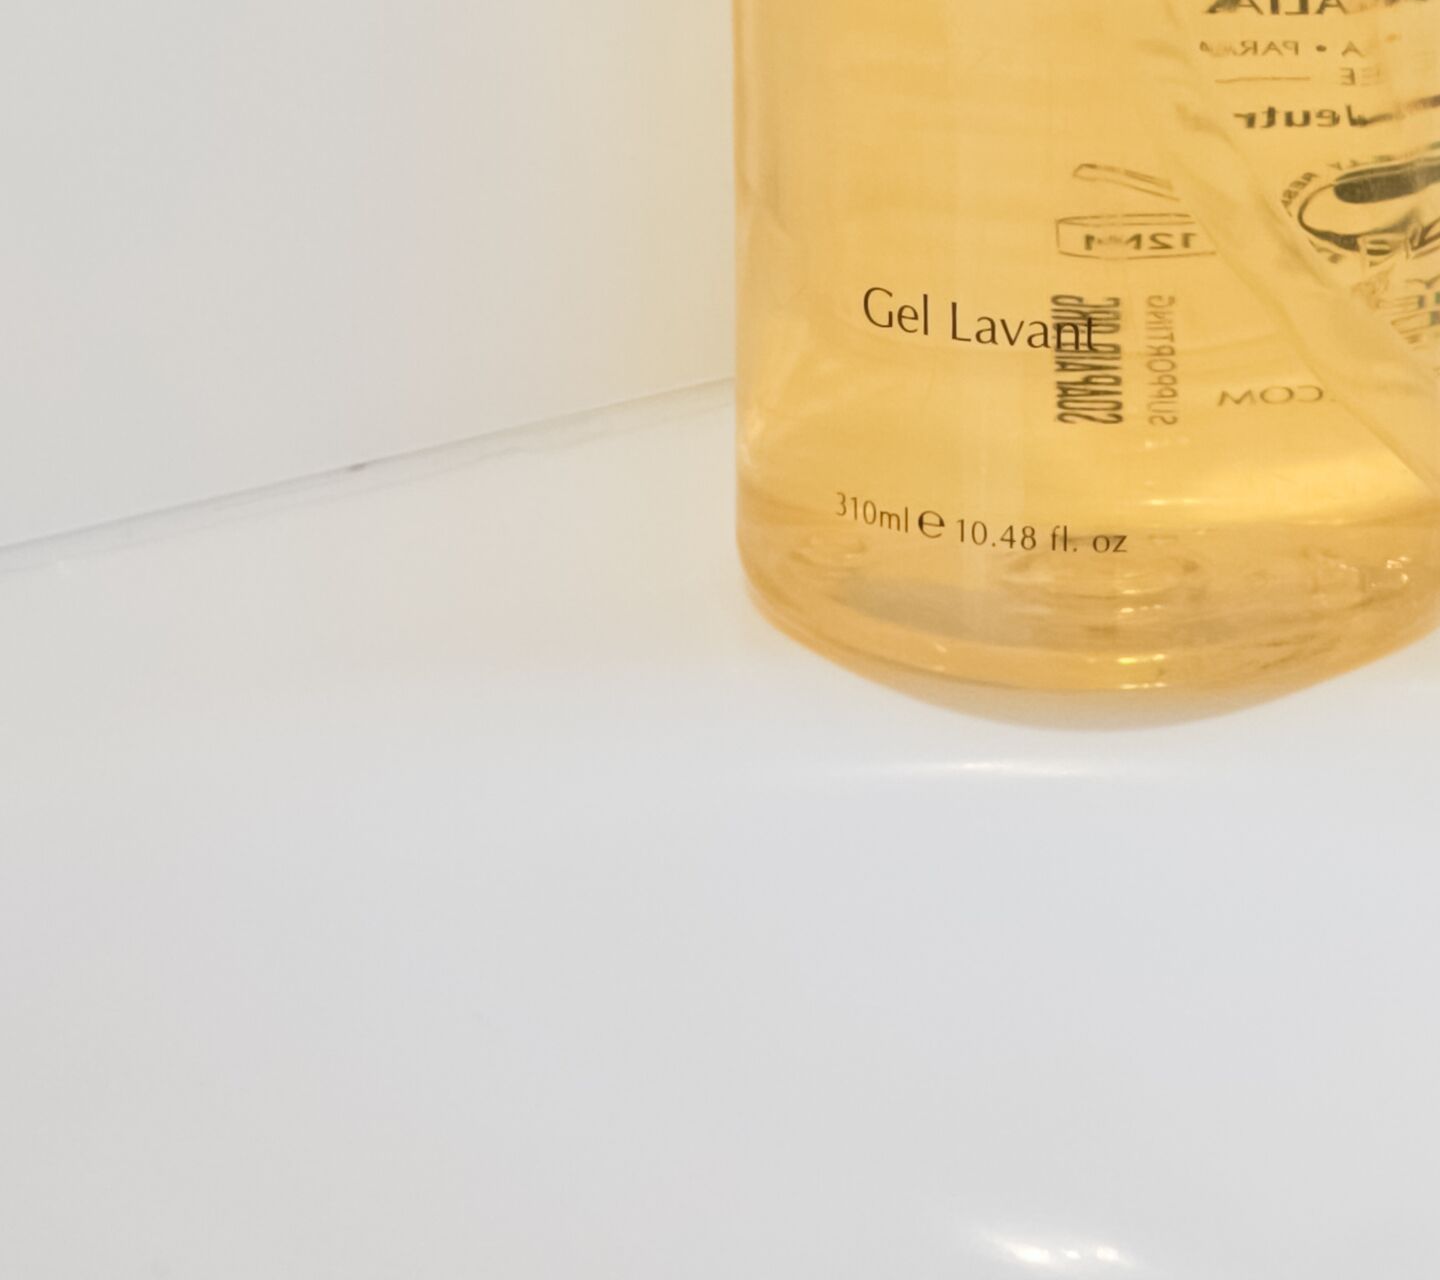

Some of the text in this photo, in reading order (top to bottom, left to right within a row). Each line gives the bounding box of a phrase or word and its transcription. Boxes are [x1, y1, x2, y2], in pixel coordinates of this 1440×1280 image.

[863, 286, 1100, 352] Gel Lavant
[835, 492, 909, 533] 310ml
[956, 519, 1037, 551] 10.48
[1051, 525, 1077, 552] fl.
[1092, 534, 1128, 553] oz
